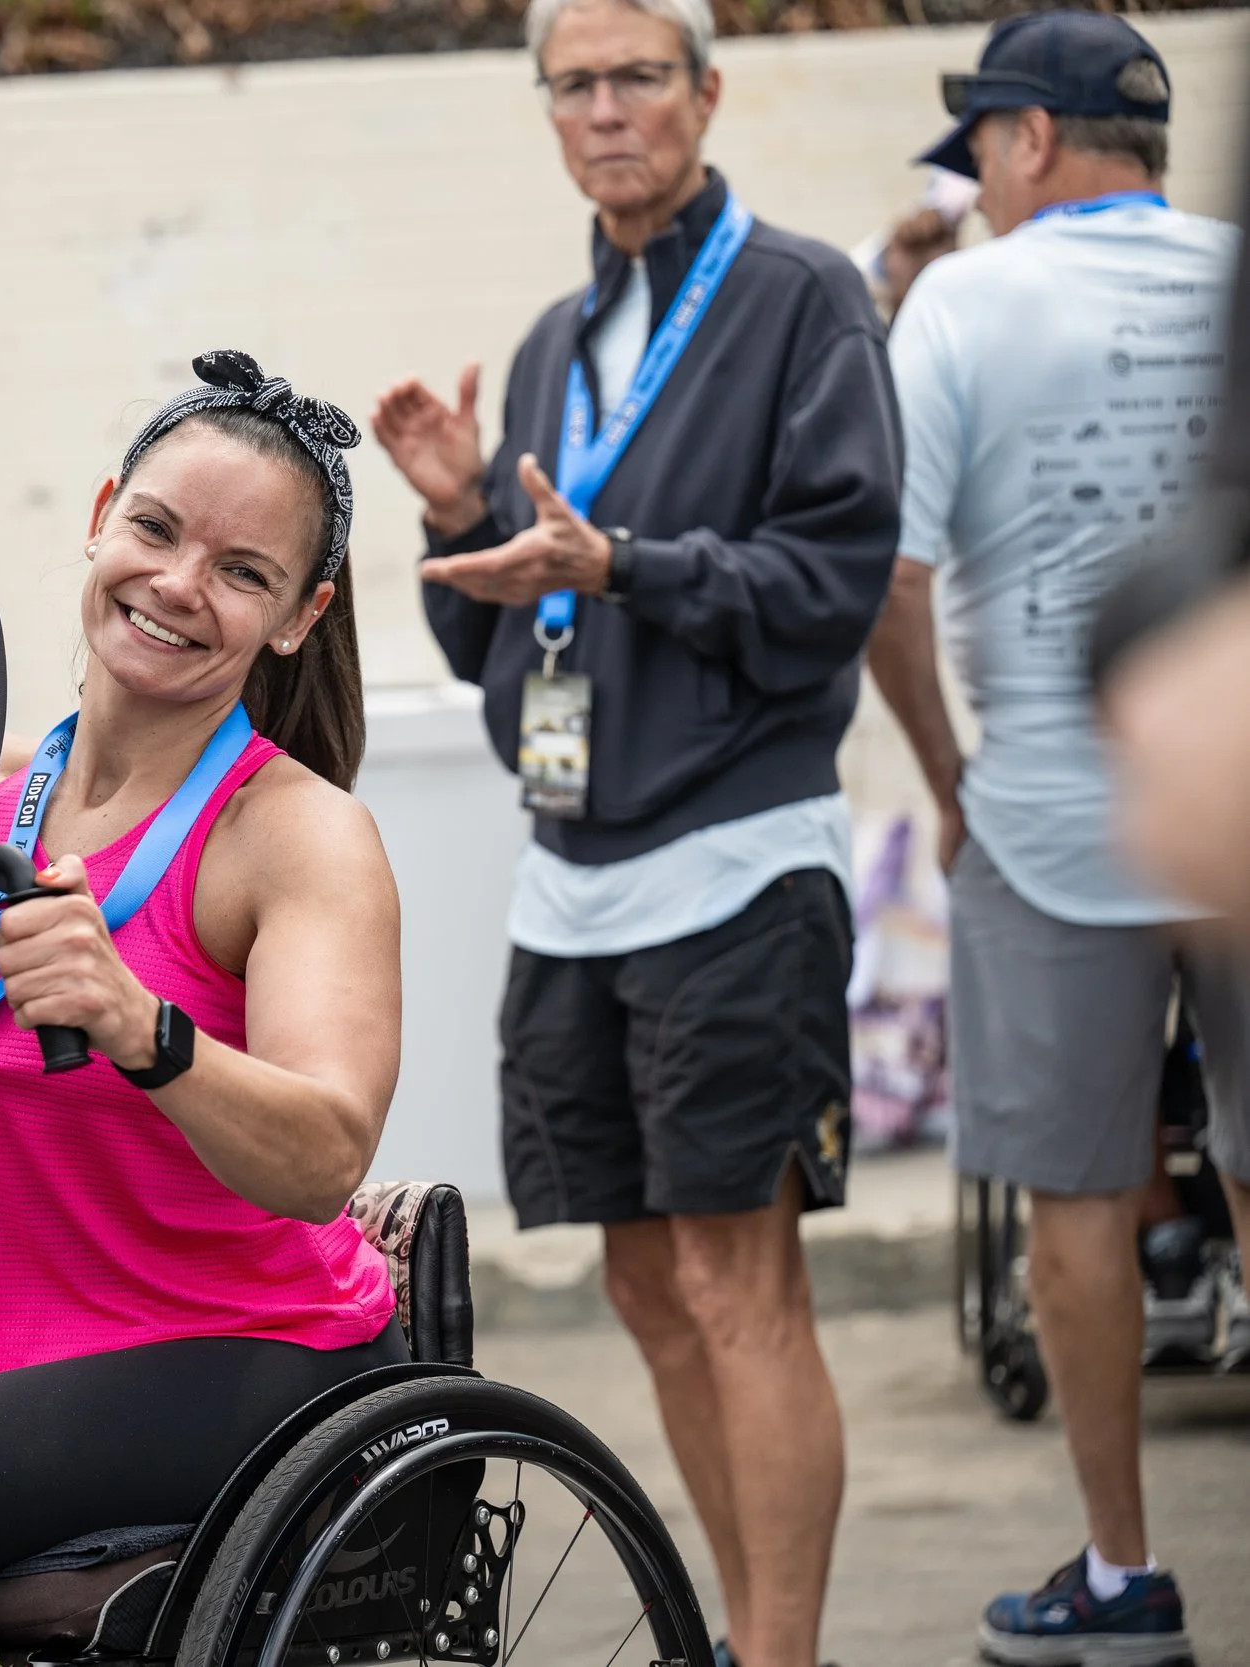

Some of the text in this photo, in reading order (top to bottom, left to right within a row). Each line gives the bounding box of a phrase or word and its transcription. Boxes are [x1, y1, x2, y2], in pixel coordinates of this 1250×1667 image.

[25, 774, 48, 802] RIDE
[19, 806, 36, 826] ON
[306, 1566, 417, 1611] OLOURS
